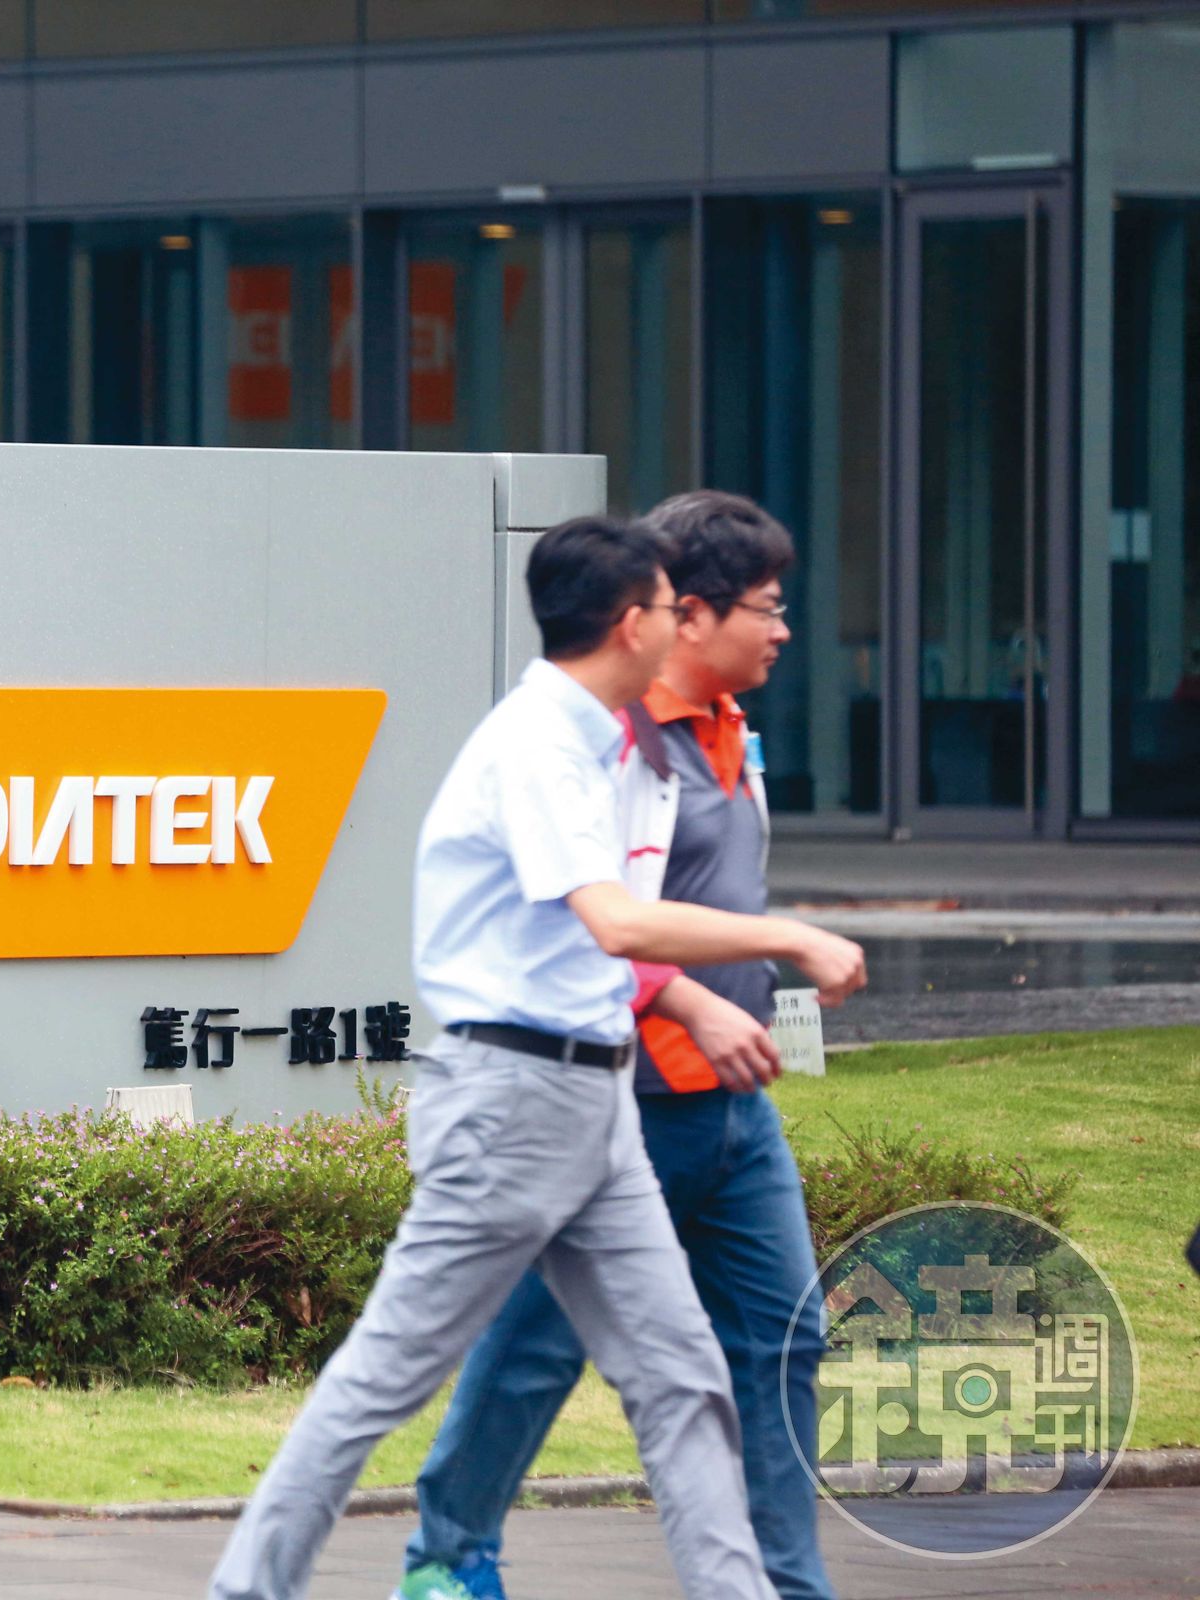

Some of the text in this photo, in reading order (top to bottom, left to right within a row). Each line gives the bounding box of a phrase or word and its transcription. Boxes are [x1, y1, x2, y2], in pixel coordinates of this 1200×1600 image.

[140, 1001, 411, 1069] 篤行一路1號
